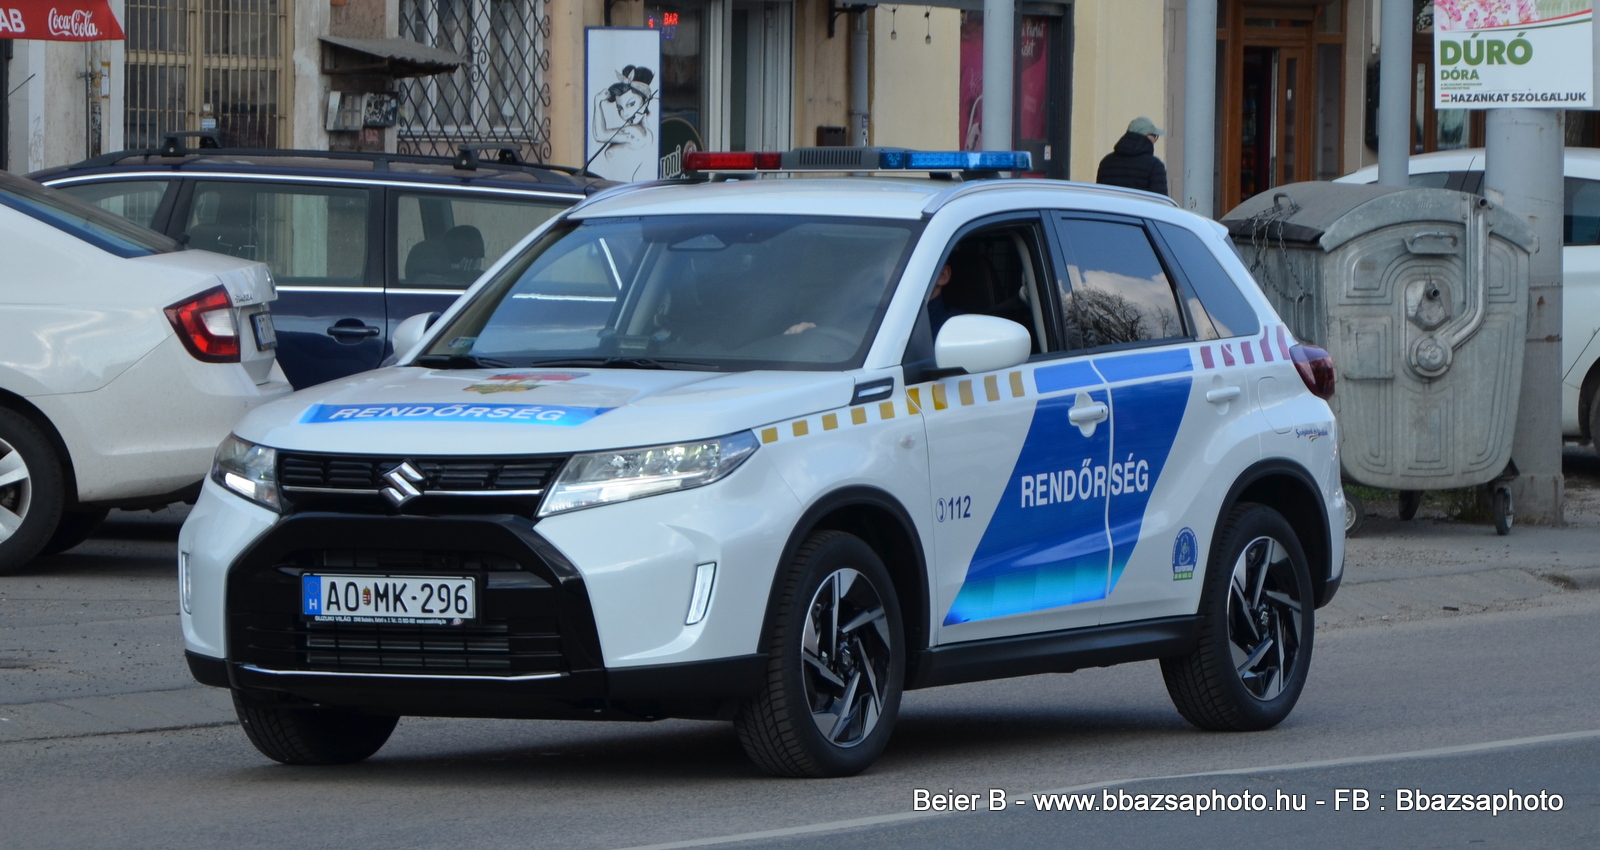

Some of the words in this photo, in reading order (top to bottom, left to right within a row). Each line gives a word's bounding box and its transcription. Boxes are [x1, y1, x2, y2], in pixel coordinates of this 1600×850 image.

[48, 7, 98, 37] Coca-Cola
[664, 12, 679, 26] BAR
[1440, 32, 1533, 65] DÚRÓ
[1440, 66, 1480, 81] DÓRA
[329, 404, 566, 421] RENDŐRSÉG
[1021, 453, 1149, 508] RENDŐRSÉG
[948, 495, 971, 520] 112
[309, 598, 318, 610] H
